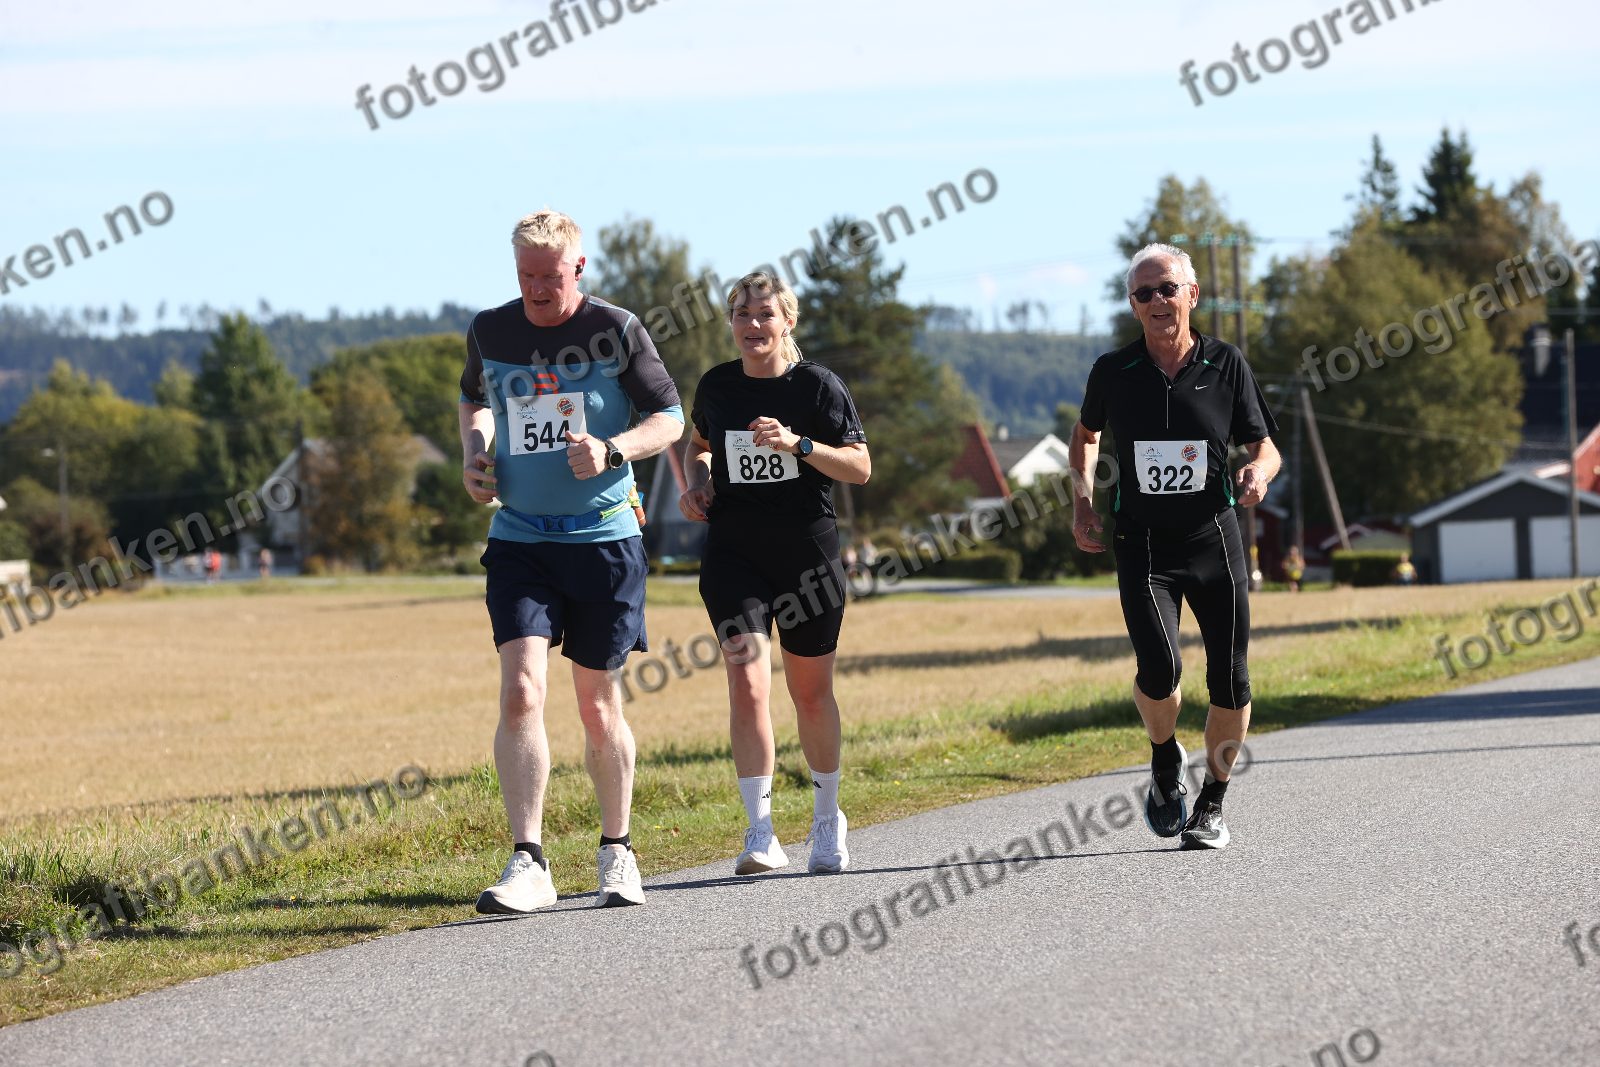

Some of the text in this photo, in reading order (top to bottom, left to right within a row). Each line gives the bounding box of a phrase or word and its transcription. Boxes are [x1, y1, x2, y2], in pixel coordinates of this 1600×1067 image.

[523, 419, 571, 452] 544
[739, 453, 785, 481] 828
[1147, 464, 1194, 493] 322
